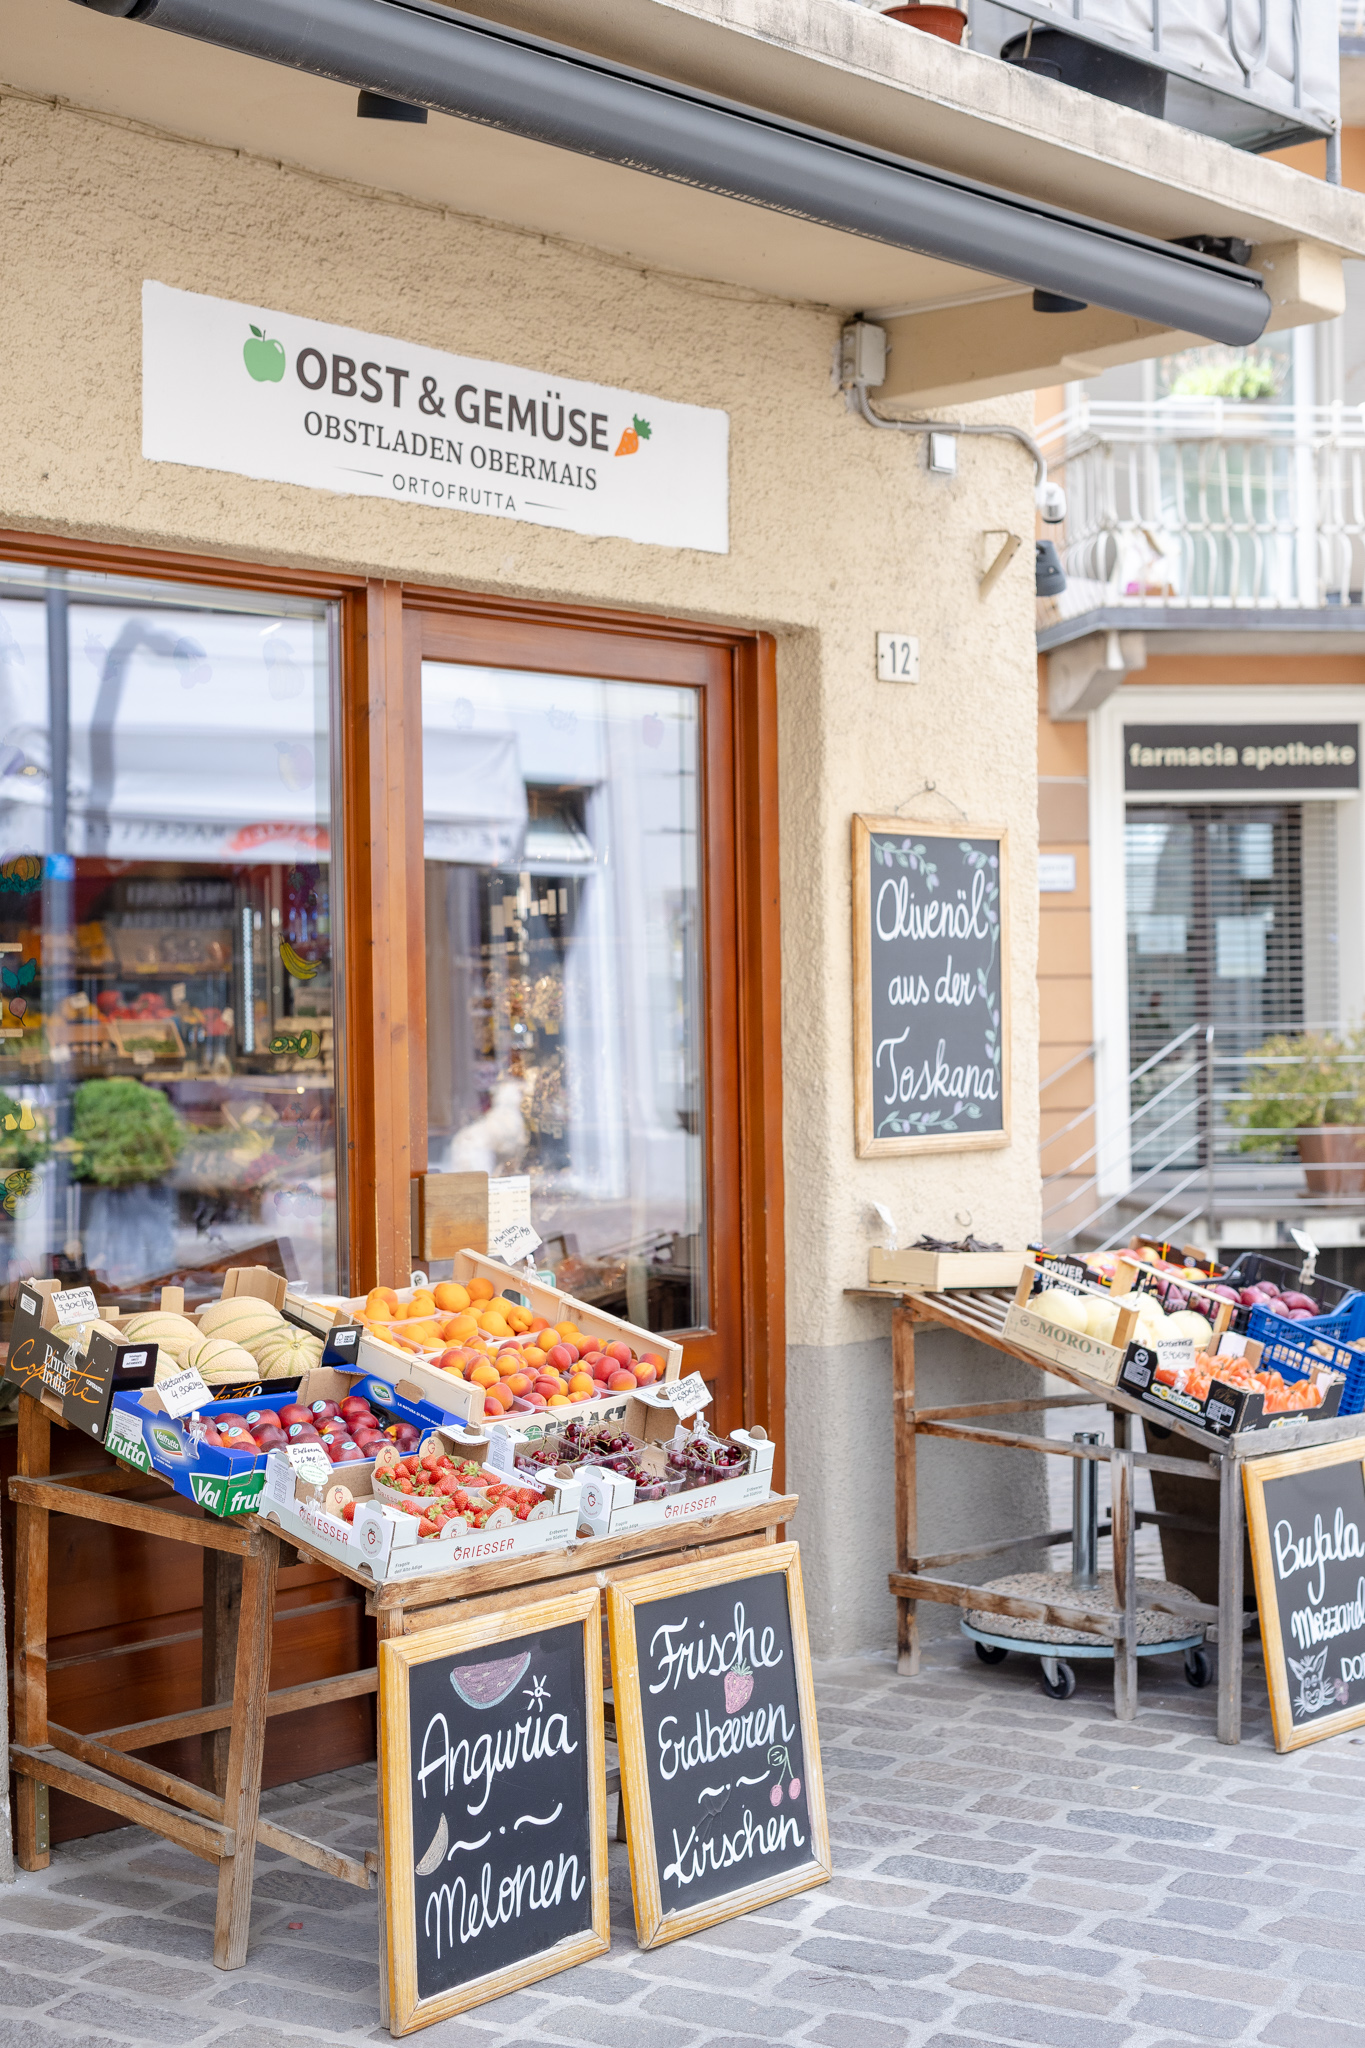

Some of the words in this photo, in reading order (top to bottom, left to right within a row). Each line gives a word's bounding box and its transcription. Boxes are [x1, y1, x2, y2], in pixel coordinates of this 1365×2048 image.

[296, 347, 410, 409] OBST
[418, 376, 446, 418] &
[455, 385, 610, 453] GEMÜSE
[303, 410, 463, 466] OBSTLADEN
[471, 444, 598, 492] OBERMAIS
[392, 474, 516, 512] ORTOFRUTTA
[889, 640, 911, 675] 12
[1129, 742, 1238, 767] farmacia
[1241, 741, 1356, 771] apotheke
[876, 868, 989, 942] Olivenöl
[888, 974, 930, 1006] aus
[934, 954, 977, 1006] der
[876, 1026, 999, 1105] Toskana
[1043, 1259, 1084, 1282] POWER
[53, 1290, 93, 1303] Melonen
[1039, 1321, 1092, 1353] MORO
[107, 1431, 147, 1468] frutta
[197, 1478, 222, 1509] Val
[664, 1495, 717, 1519] GRIESSER
[453, 1537, 515, 1561] GRIESSER
[648, 1601, 783, 1694] Frische
[417, 1711, 579, 1816] Anguria
[658, 1703, 796, 1781] Erdbeeren
[663, 1805, 806, 1889] Kirschen
[425, 1852, 586, 1960] Melonen
